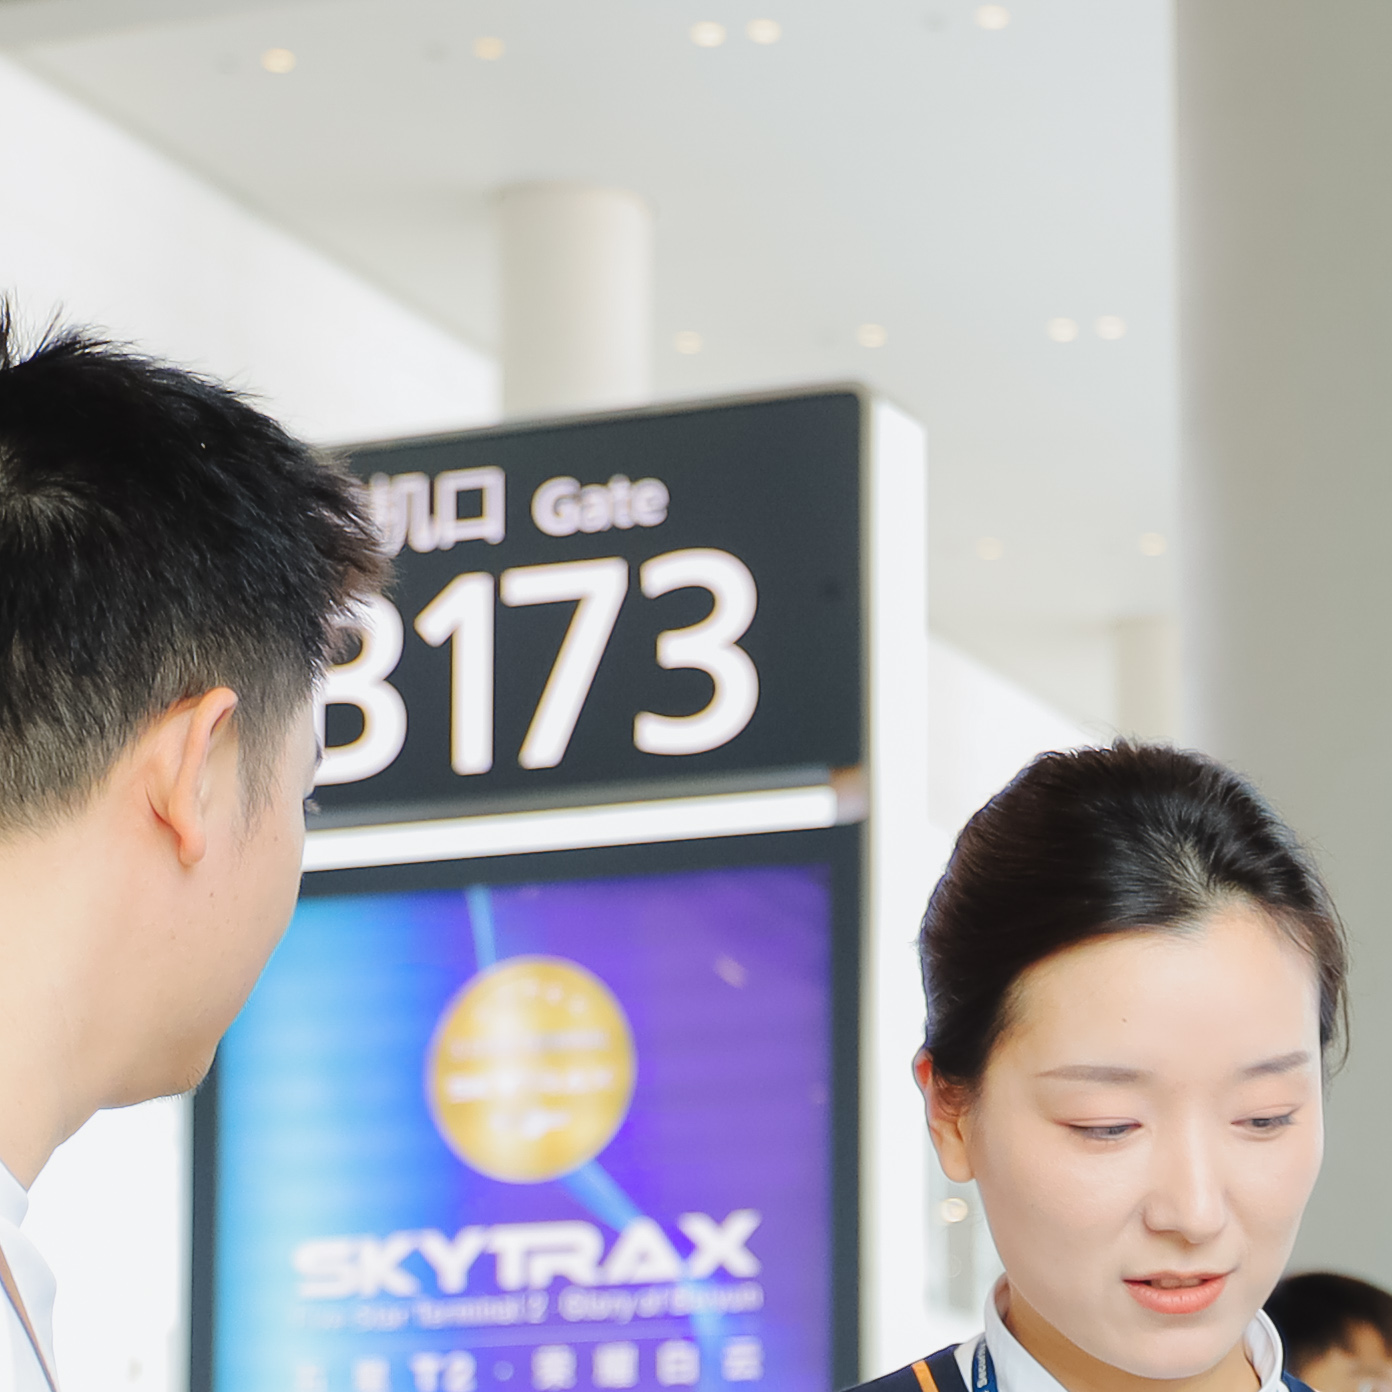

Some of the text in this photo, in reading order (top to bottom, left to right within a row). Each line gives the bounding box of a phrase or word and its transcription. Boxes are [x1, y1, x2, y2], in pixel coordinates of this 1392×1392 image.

[530, 474, 671, 537] Gate
[312, 547, 759, 787] B173
[292, 1208, 764, 1299] SKYTRAX
